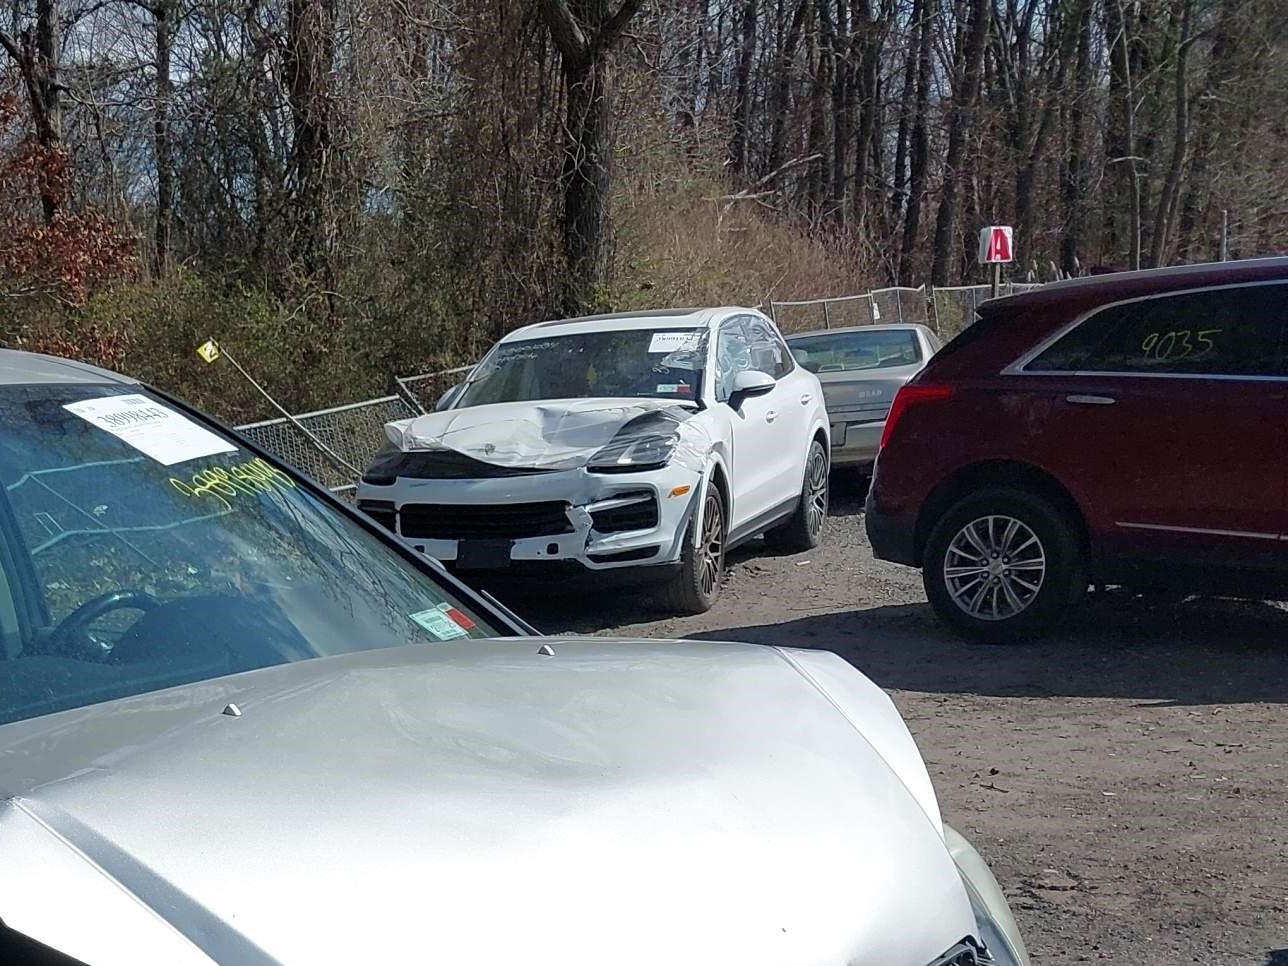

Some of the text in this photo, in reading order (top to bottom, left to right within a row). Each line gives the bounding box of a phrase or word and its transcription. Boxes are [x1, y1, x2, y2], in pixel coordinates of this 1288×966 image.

[986, 228, 1011, 261] A
[1142, 329, 1223, 363] 9035
[96, 406, 169, 428] 38998443
